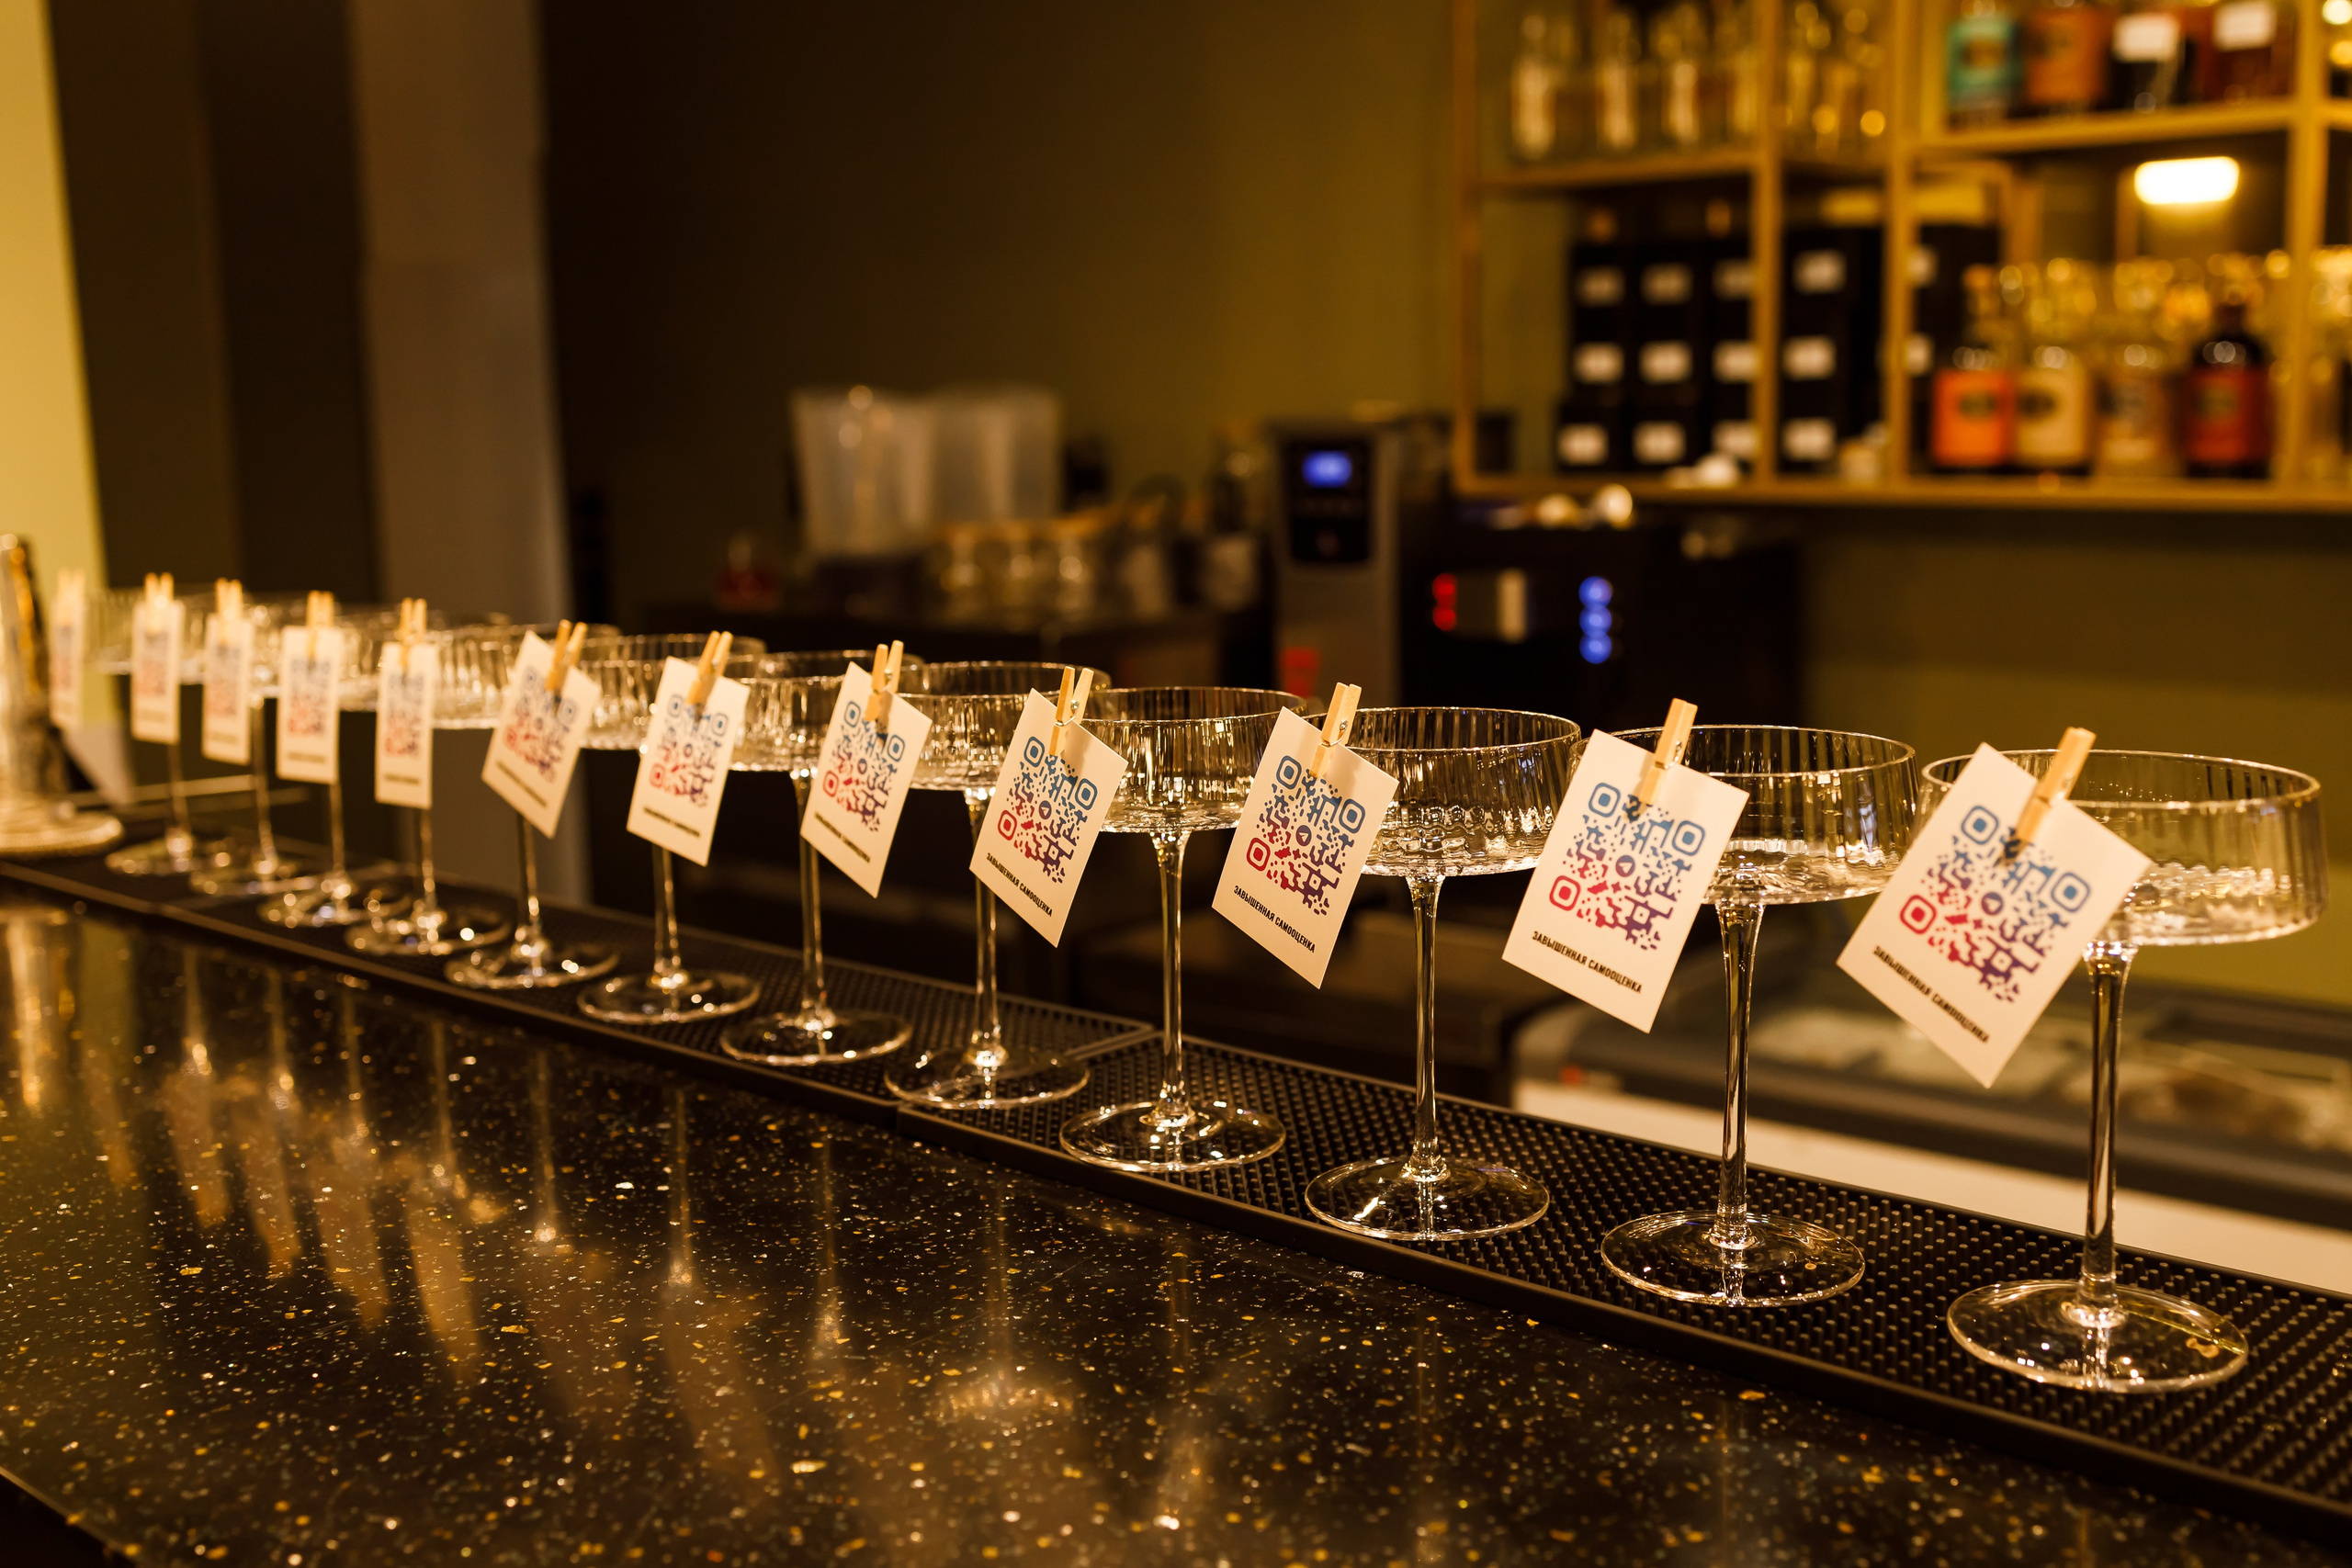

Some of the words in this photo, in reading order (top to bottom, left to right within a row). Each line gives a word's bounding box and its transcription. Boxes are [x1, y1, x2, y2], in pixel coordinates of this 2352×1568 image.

[1234, 886, 1275, 921] ЗАВЫШЕННАЯ
[1274, 917, 1316, 953] САМООЦЕНКА
[1532, 931, 1587, 965] ЗАВЫШЕННАЯ
[1589, 959, 1642, 994] САМООЦЕНКА
